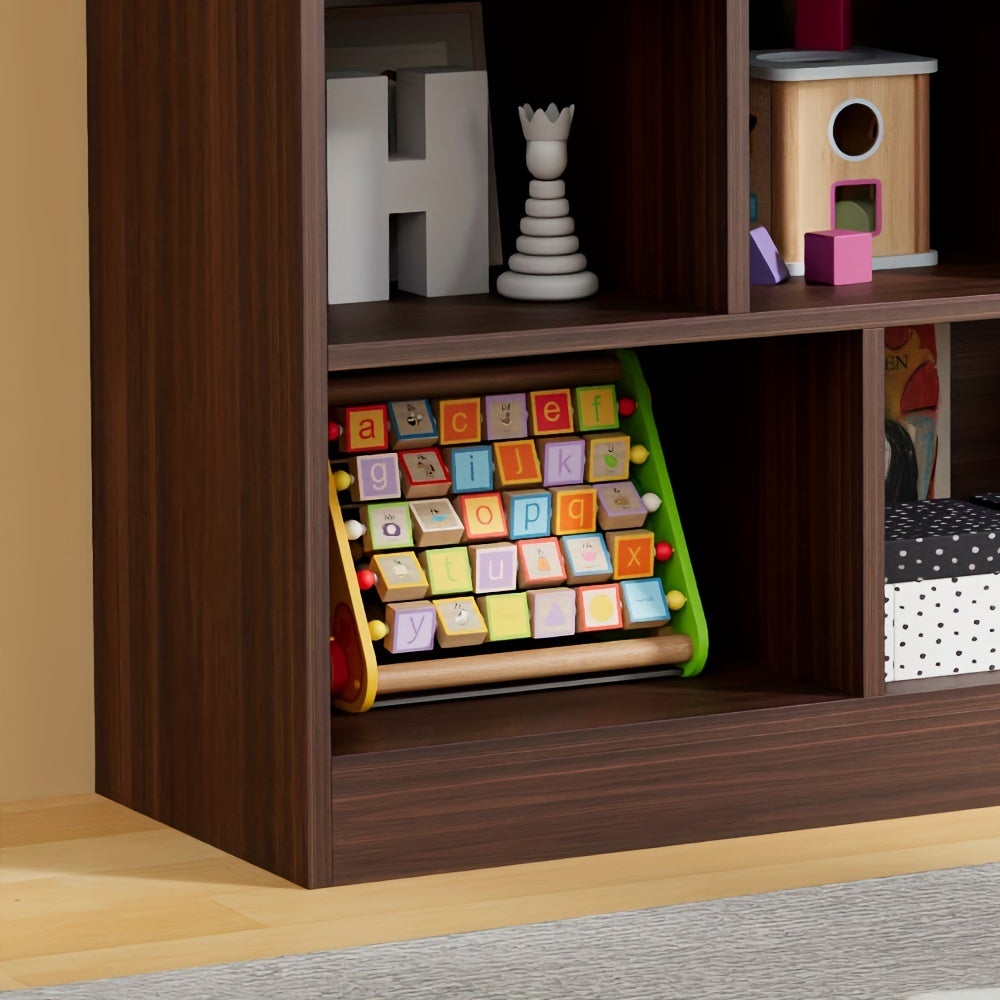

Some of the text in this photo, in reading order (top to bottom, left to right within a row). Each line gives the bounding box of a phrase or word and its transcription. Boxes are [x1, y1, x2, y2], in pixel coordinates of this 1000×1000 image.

[326, 66, 490, 305] H
[359, 418, 375, 439] a
[543, 401, 561, 422] e
[592, 394, 601, 422] f
[370, 462, 388, 491] g
[469, 454, 475, 482] i
[557, 449, 572, 475] k
[524, 502, 540, 531] p
[568, 498, 585, 528] q
[444, 555, 456, 582] t
[488, 560, 504, 581] u
